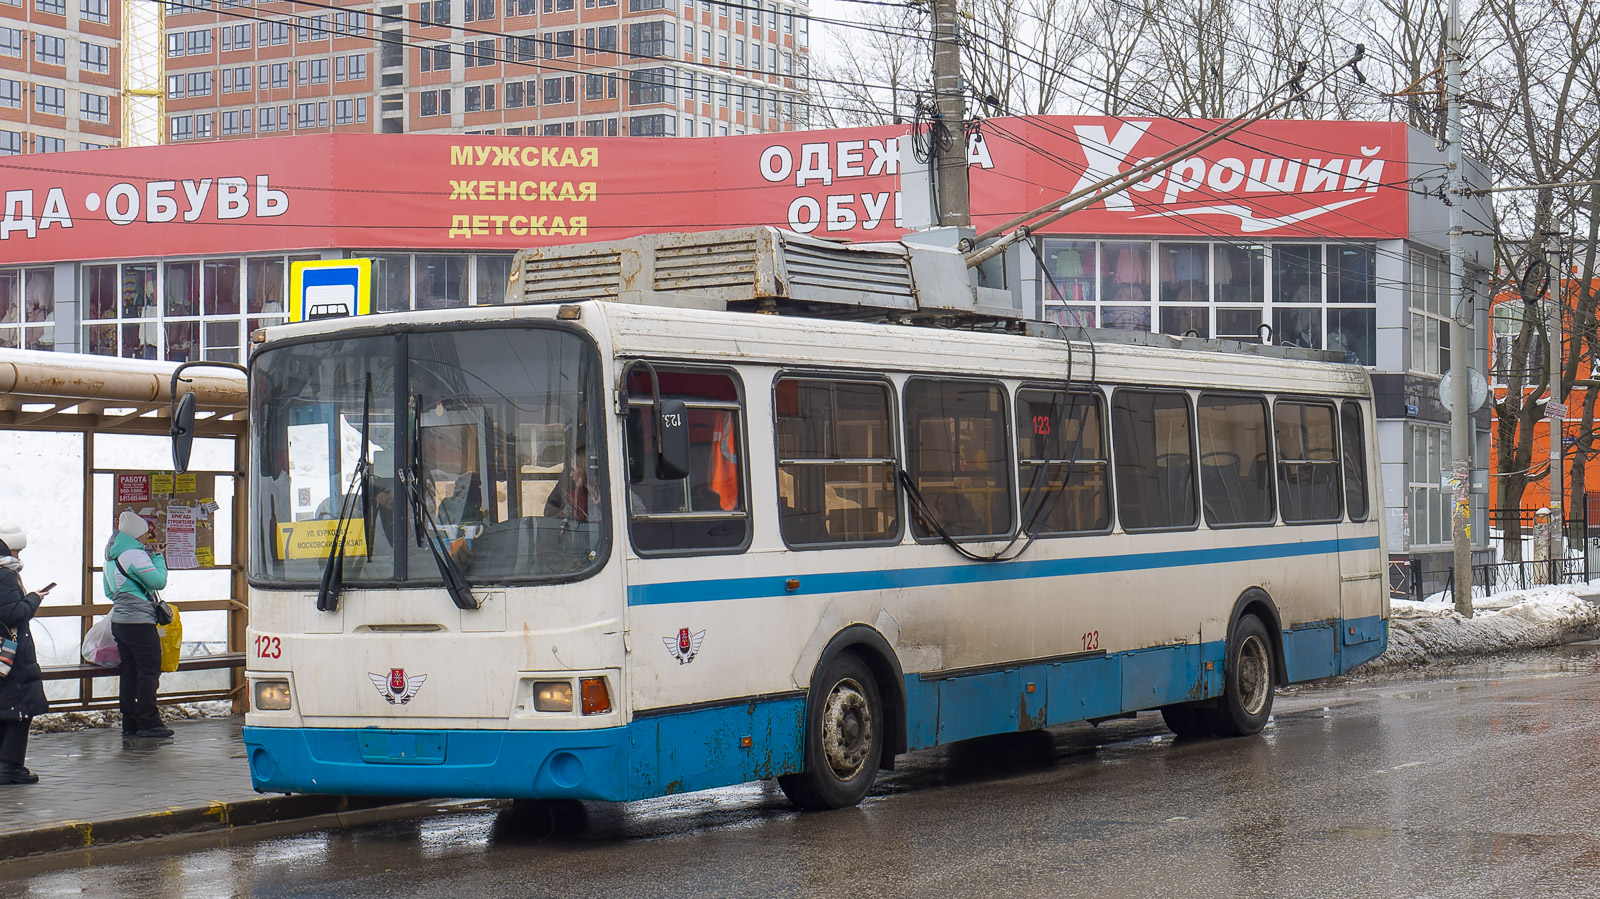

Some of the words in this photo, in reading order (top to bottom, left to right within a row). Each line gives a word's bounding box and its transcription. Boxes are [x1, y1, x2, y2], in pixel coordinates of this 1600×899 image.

[450, 145, 599, 167] МУЖСКАЯ
[759, 132, 995, 188] ОДЕЖА
[1057, 121, 1386, 212] Хороший
[449, 179, 597, 202] ЖЕНСКАЯ
[0, 187, 74, 240] ДА
[105, 174, 290, 226] ОБУВЬ
[448, 214, 588, 239] ДЕТСКАЯ
[1032, 415, 1050, 435] 123
[282, 527, 294, 559] 7
[254, 635, 282, 659] 123
[1081, 630, 1099, 651] 123
